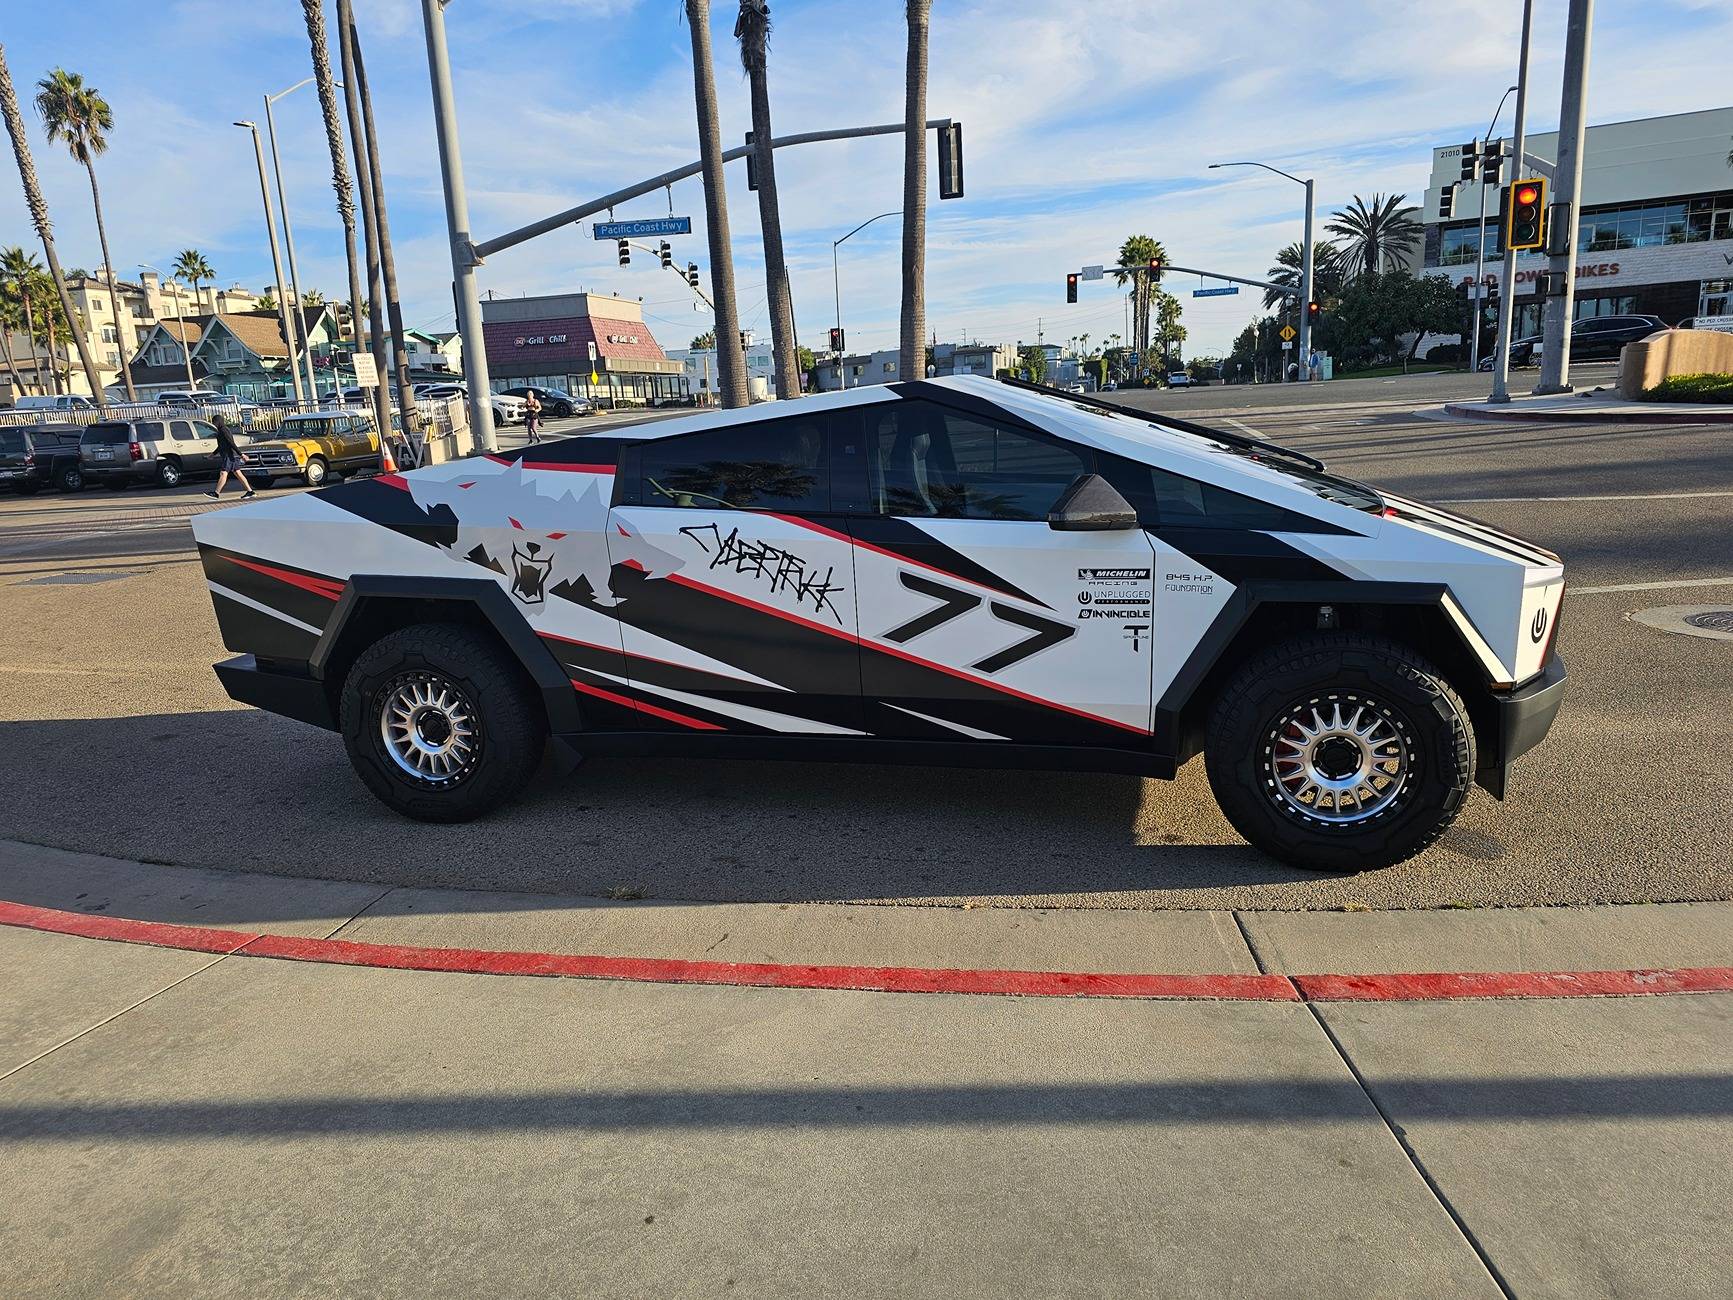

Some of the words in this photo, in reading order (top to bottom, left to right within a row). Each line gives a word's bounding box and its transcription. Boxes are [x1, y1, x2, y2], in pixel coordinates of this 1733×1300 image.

[1440, 149, 1460, 159] 21010
[601, 223, 632, 235] Pacific
[633, 222, 660, 232] Coast
[661, 220, 682, 231] Hwy
[528, 336, 544, 345] Grill
[549, 334, 567, 343] Chill
[1165, 583, 1213, 593] FOUNDATION
[1094, 590, 1151, 598] UNPLUGGED
[1092, 610, 1151, 619] INVINCIBLE
